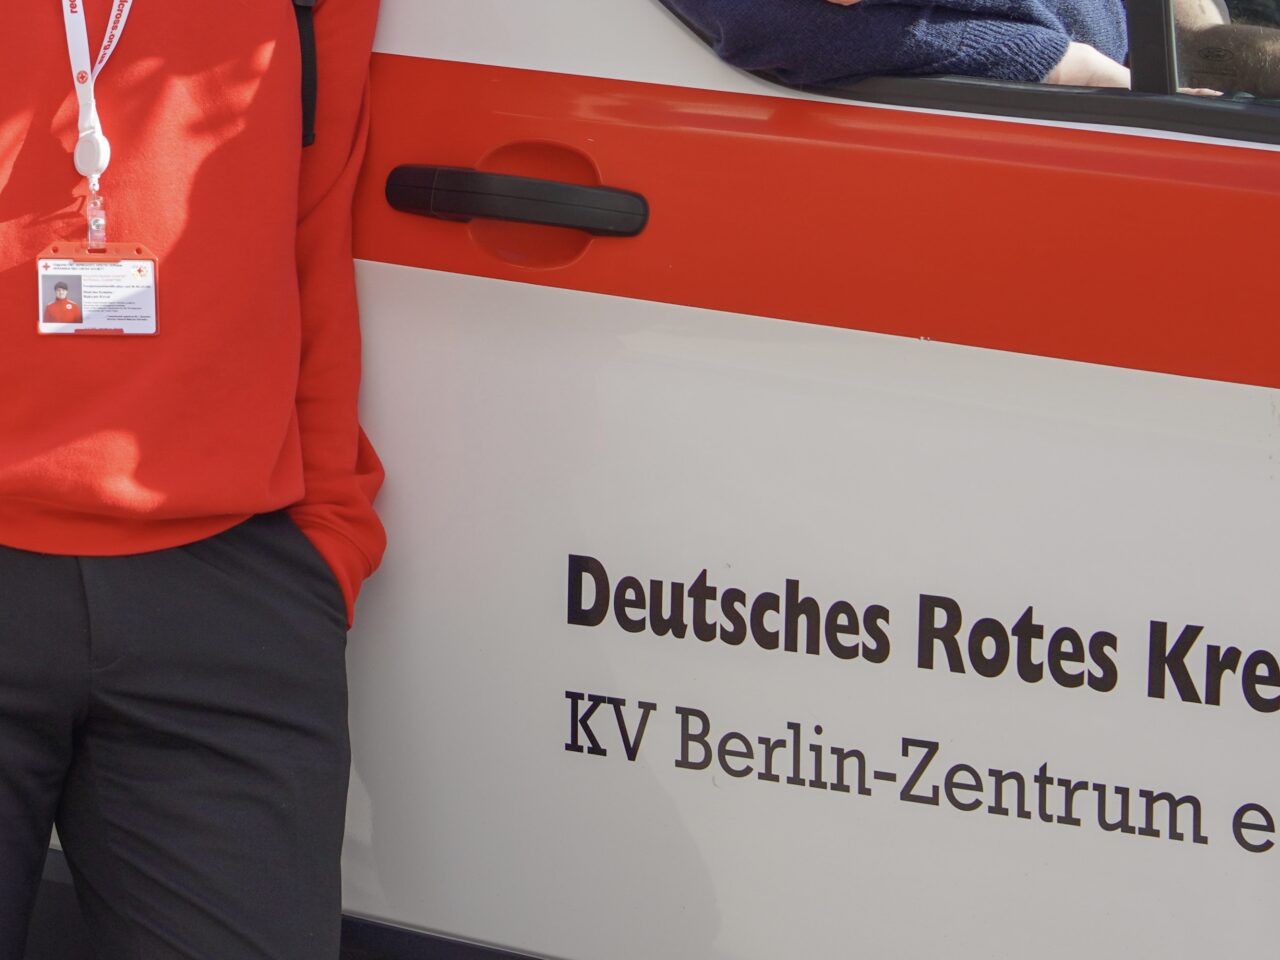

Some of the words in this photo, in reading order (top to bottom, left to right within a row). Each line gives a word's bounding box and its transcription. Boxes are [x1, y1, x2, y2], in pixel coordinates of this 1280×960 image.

[567, 554, 891, 664] Deutsches
[917, 593, 1118, 692] Rotes
[1147, 620, 1280, 714] Kre
[565, 690, 657, 762] KV
[674, 705, 1209, 845] Berlin-Zentrum
[1232, 802, 1276, 854] e
